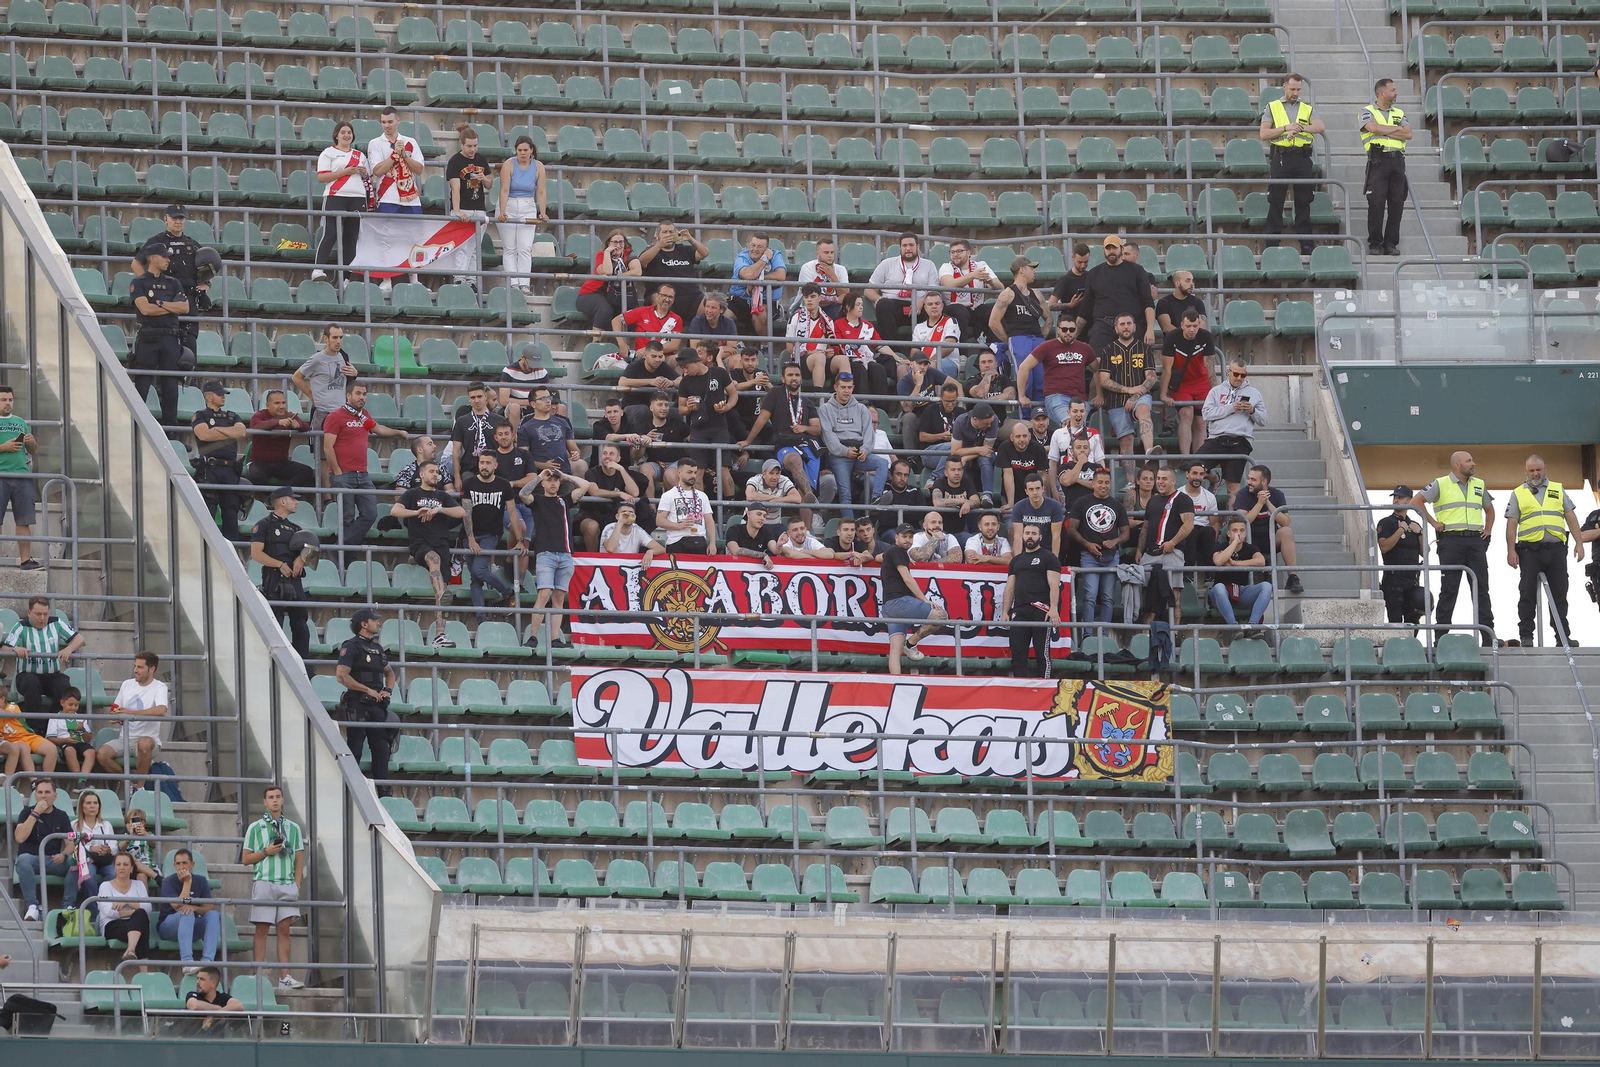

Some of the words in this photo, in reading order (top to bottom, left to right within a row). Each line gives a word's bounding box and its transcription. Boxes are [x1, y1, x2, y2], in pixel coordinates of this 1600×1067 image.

[1132, 358, 1144, 368] 36
[1587, 371, 1599, 379] 221
[576, 668, 1075, 776] Vallekas
